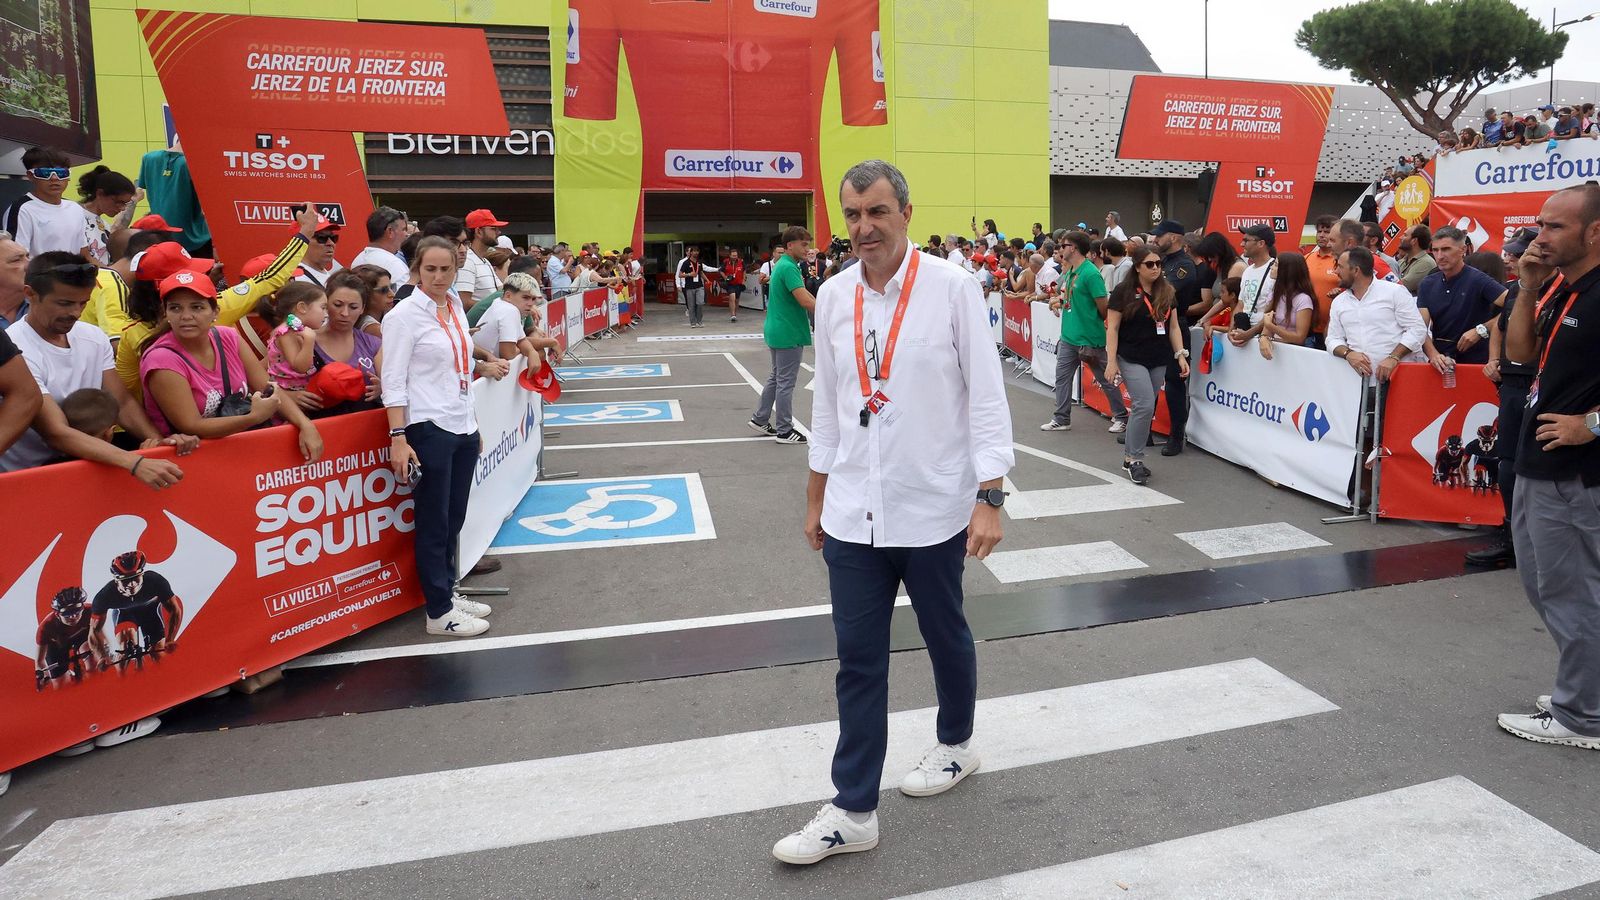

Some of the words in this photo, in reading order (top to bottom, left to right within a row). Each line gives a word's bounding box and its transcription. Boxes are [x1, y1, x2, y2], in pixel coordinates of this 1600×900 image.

[759, 0, 812, 13] Carrefour
[246, 52, 352, 74] CARREFOUR
[355, 57, 405, 76] JEREZ
[409, 60, 448, 78] SUR.
[250, 73, 304, 92] JEREZ
[307, 76, 332, 93] DE
[335, 77, 356, 94] LA
[361, 78, 446, 97] FRONTERA
[1163, 99, 1226, 116] CARREFOUR
[1227, 104, 1258, 118] JEREZ
[1259, 105, 1283, 119] SUR.
[1165, 115, 1197, 129] JEREZ
[1199, 117, 1213, 130] DE
[1215, 118, 1228, 131] LA
[1230, 118, 1281, 134] FRONTERA
[223, 151, 325, 171] TISSOT
[672, 155, 764, 173] Carrefour
[1237, 179, 1294, 193] TISSOT
[244, 205, 261, 220] LA
[321, 207, 339, 221] 24
[1503, 215, 1536, 225] CARREFOUR
[1231, 218, 1241, 229] LA
[1275, 219, 1285, 230] 24
[1387, 225, 1398, 238] 24
[1205, 381, 1286, 424] Carrefour
[474, 427, 518, 487] Carrefour
[255, 462, 334, 492] CARREFOUR
[336, 453, 359, 476] CON
[361, 451, 376, 468] LA
[255, 498, 415, 579] EQUIPO
[343, 576, 376, 593] Carrefour
[272, 599, 288, 612] LA
[289, 581, 332, 606] VUELTA
[270, 587, 402, 644] #CARREFOURCONLAVUELTA
